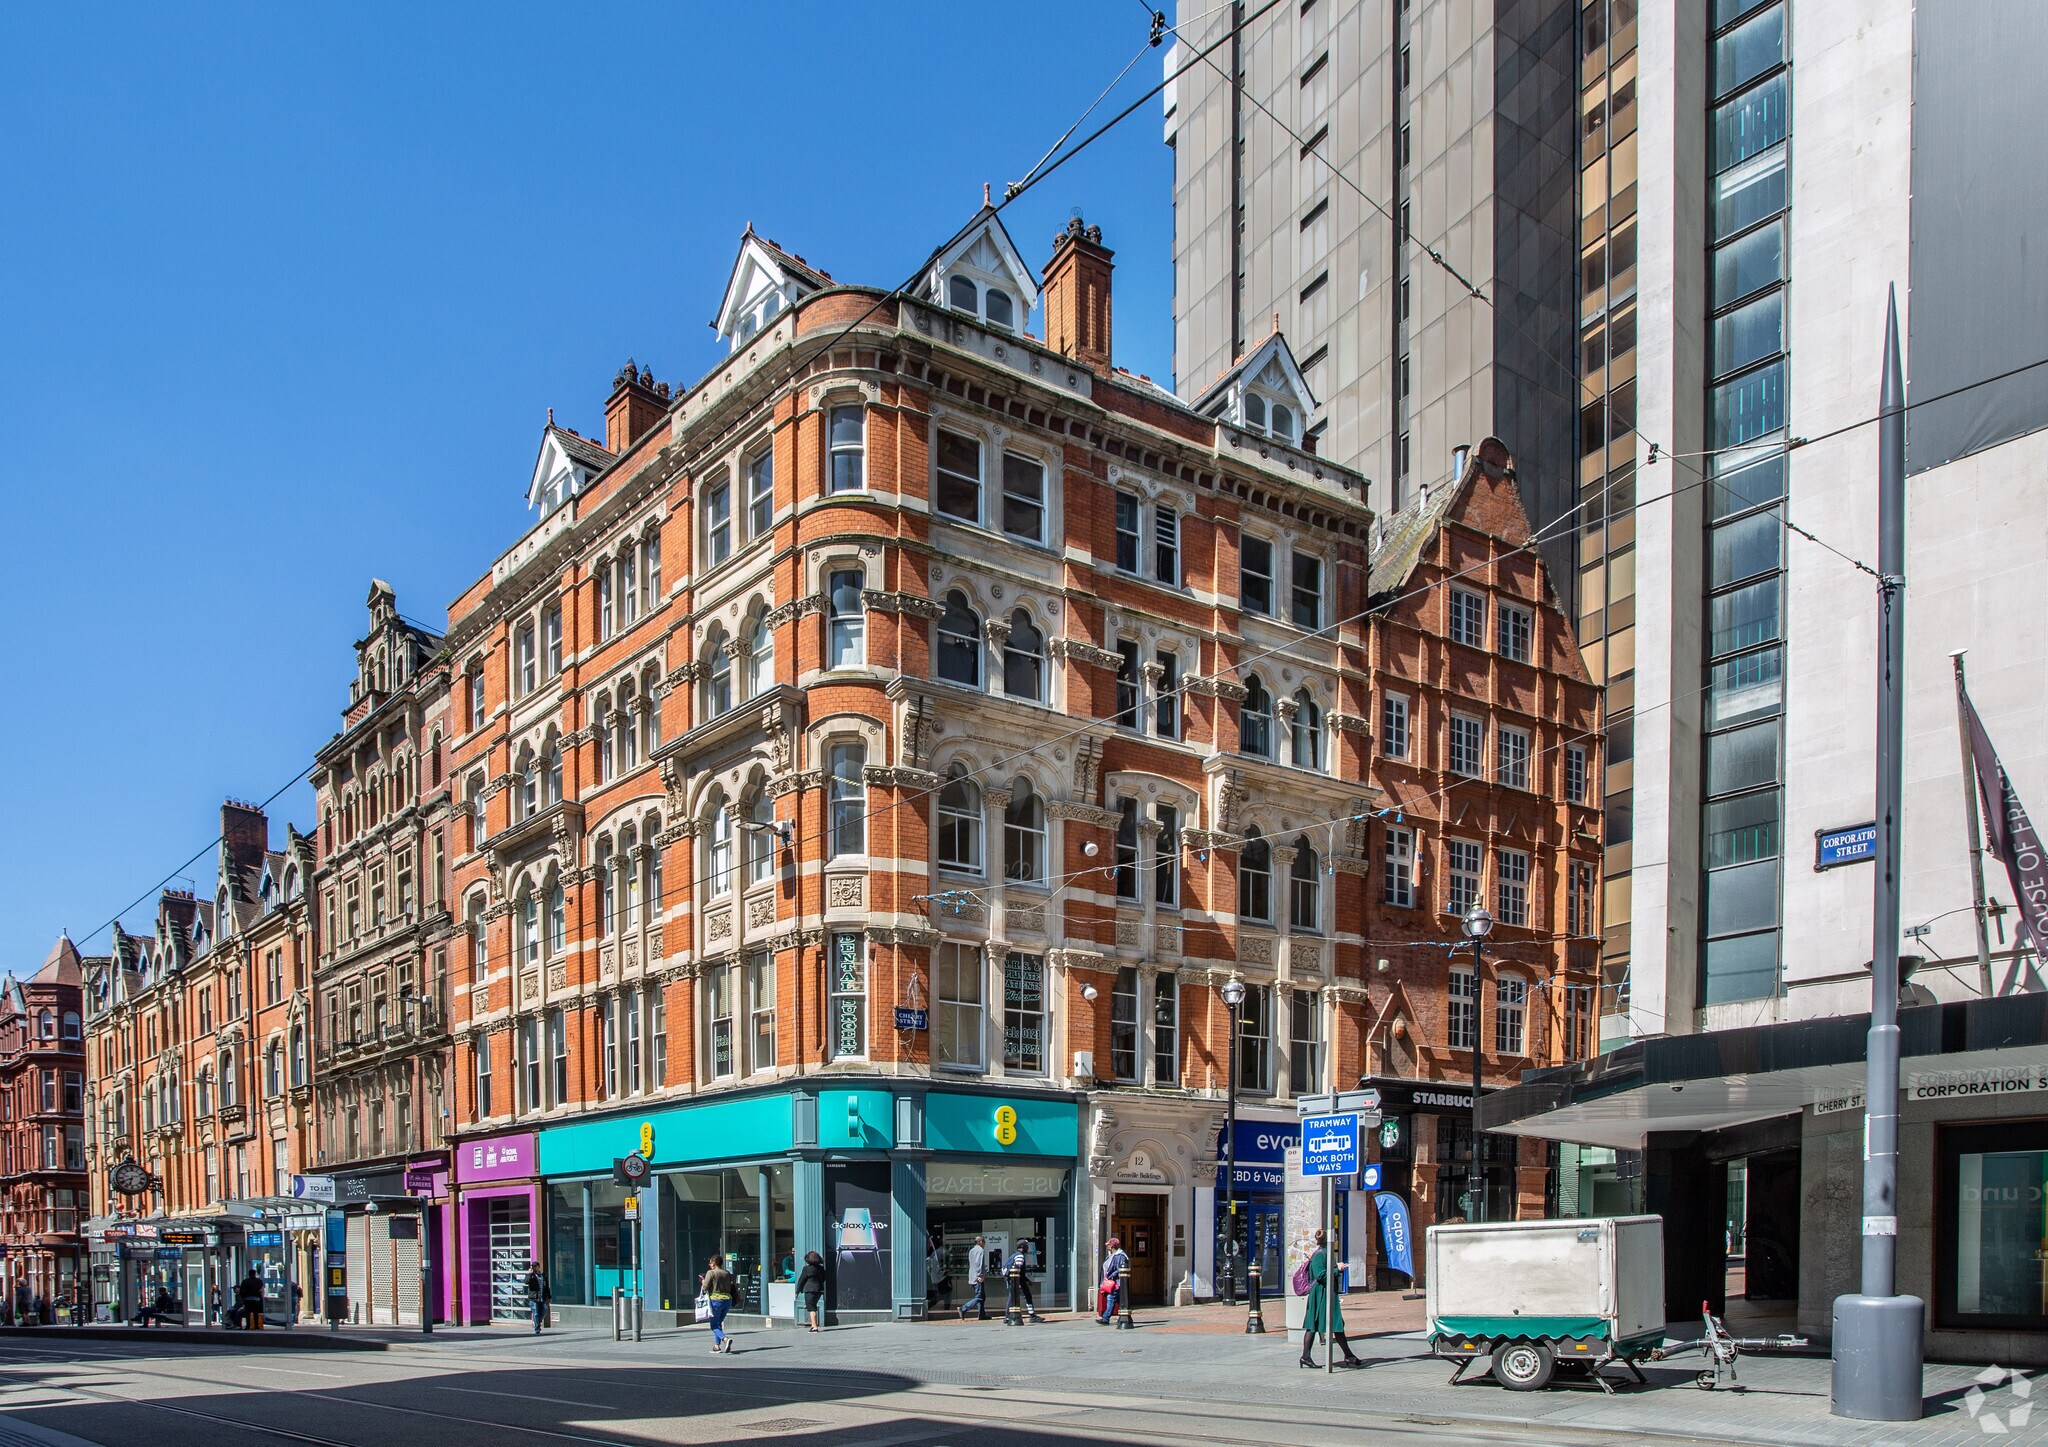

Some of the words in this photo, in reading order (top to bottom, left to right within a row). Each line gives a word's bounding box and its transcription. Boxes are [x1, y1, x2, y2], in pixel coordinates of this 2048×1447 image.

[1823, 830, 1876, 848] CORPORATIO
[1836, 843, 1868, 857] STREET
[2013, 841, 2039, 871] OF
[840, 934, 855, 991] DENTAL
[1005, 970, 1040, 980] PRIVATE
[1005, 979, 1043, 991] ATIENTS
[841, 998, 857, 1055] SURGERY
[1917, 1079, 2029, 1098] CORPORATION
[1818, 1098, 1848, 1113] CHERRY
[1851, 1095, 1861, 1107] ST
[1309, 1118, 1351, 1129] TRAMWAY
[1135, 1156, 1143, 1166] 12
[1305, 1155, 1328, 1164] LOOK
[1331, 1153, 1354, 1162] BOTH
[1318, 1163, 1341, 1171] WAYS
[1140, 1172, 1161, 1180] Buildings
[1254, 1172, 1261, 1182] &
[1263, 1172, 1284, 1185] Vapi
[832, 1222, 867, 1230] Galaxy
